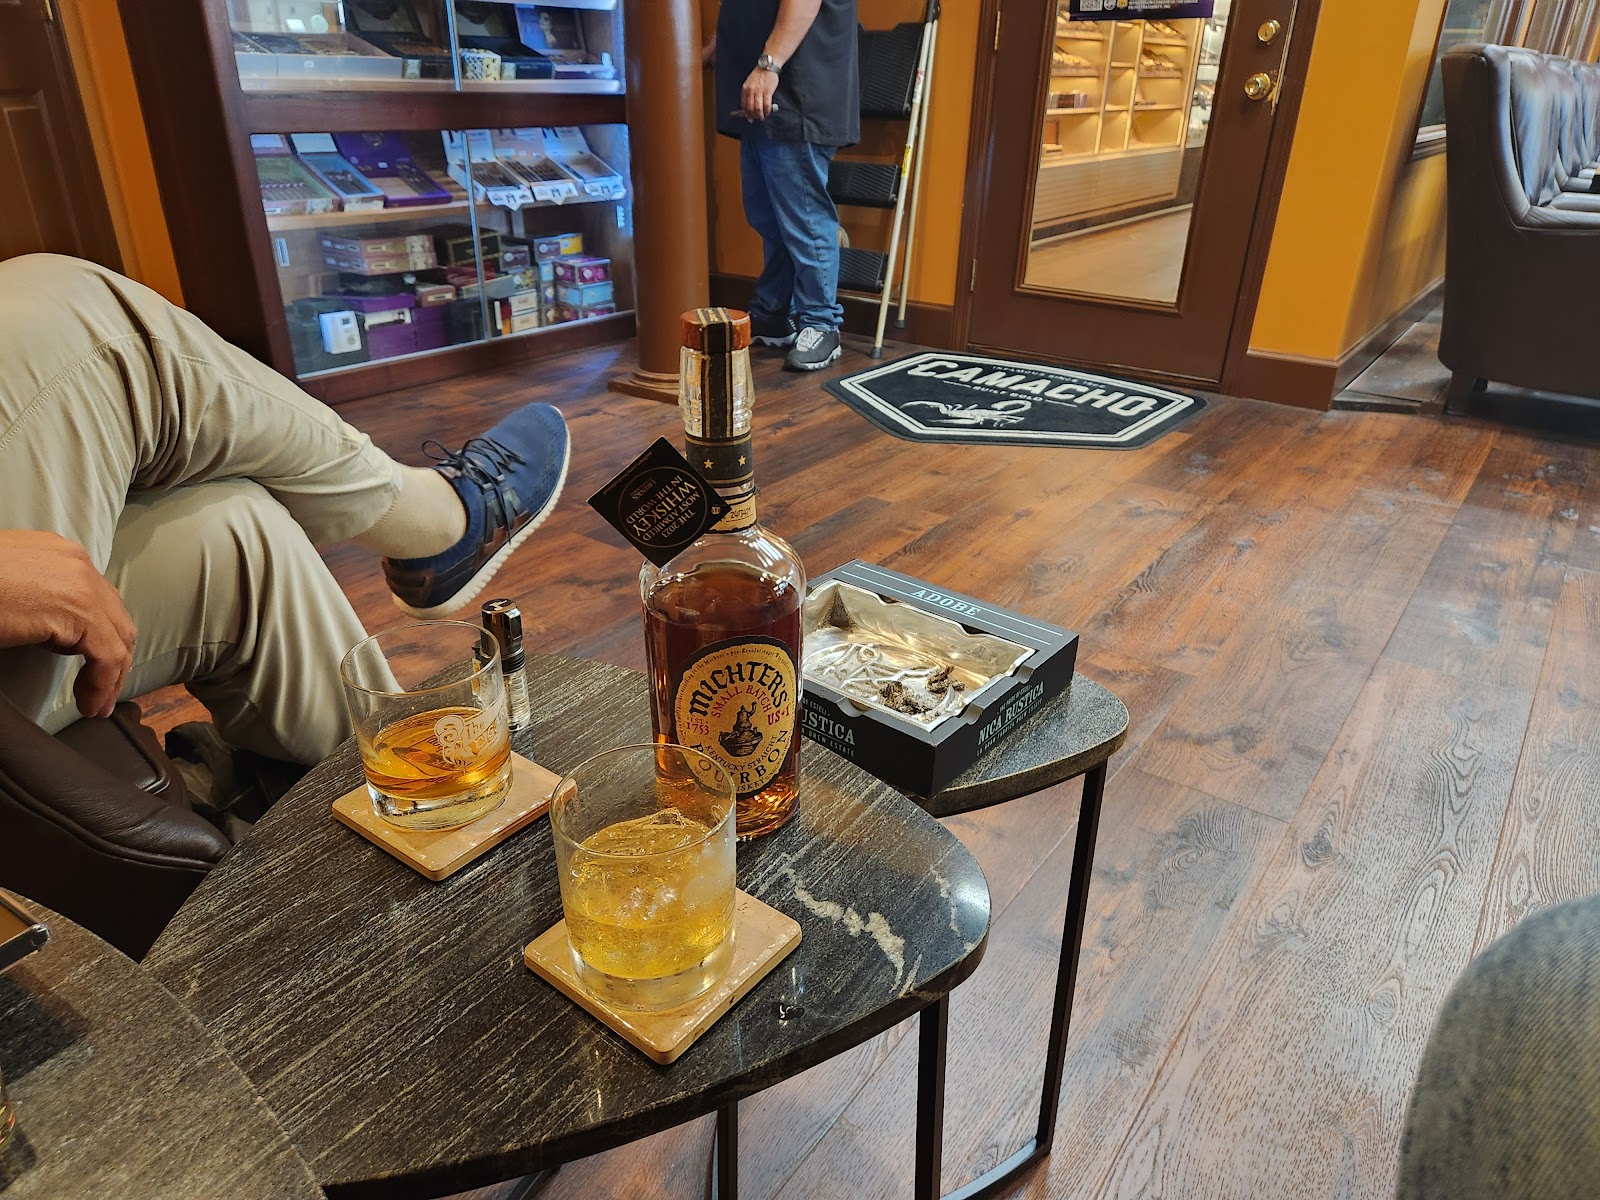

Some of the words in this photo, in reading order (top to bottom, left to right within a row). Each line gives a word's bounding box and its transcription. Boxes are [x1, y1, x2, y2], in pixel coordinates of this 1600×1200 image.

[993, 366, 1045, 376] INFAMOUS
[1048, 374, 1079, 383] SINCE
[907, 360, 1157, 417] CAMACHO
[973, 386, 1008, 395] BUILT
[1009, 393, 1043, 402] BOLD
[631, 479, 656, 501] DRINKS
[653, 484, 672, 501] THE
[670, 474, 683, 486] IN
[625, 498, 657, 525] WORLD
[633, 481, 697, 536] WHISKEY
[677, 491, 700, 511] MOST
[642, 509, 679, 542] ADMIRED
[661, 521, 680, 538] 2023
[676, 509, 696, 525] THE
[911, 589, 982, 617] ADOBE
[689, 661, 788, 717] MICHTER'S
[711, 686, 743, 718] SMALL
[745, 685, 772, 713] BATCH
[979, 715, 1002, 745] NICA
[1004, 681, 1044, 723] RUSTICA
[686, 722, 710, 735] 1753
[802, 709, 855, 745] USTICA
[705, 744, 747, 772] KENTUCKY
[747, 736, 778, 770] STRAIGHT
[808, 731, 827, 743] DREW
[830, 741, 855, 756] ESTATE
